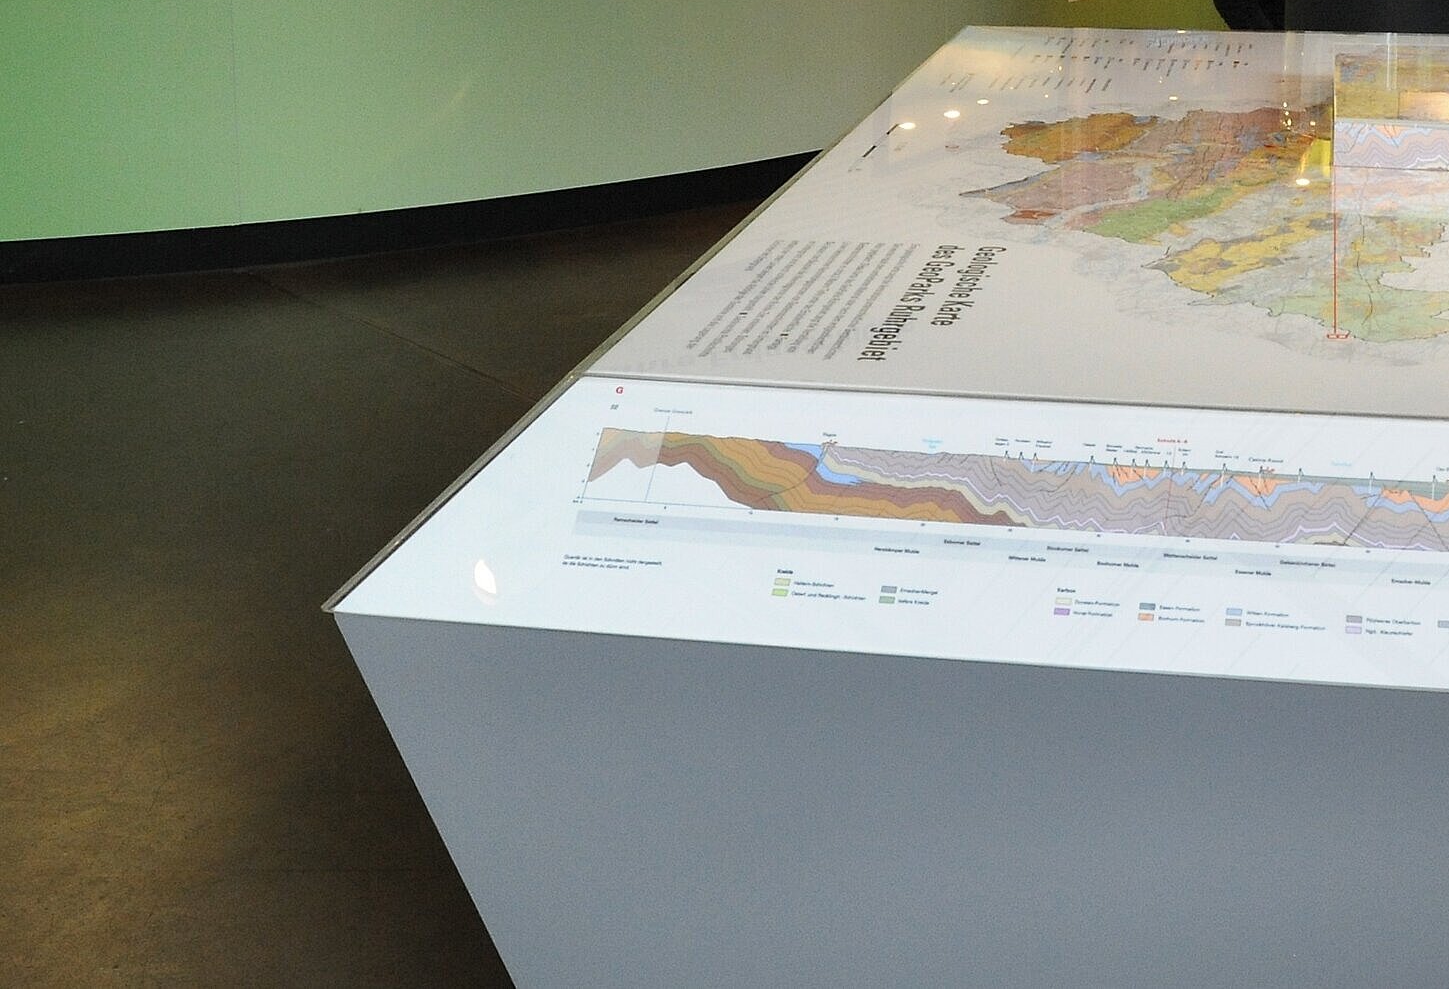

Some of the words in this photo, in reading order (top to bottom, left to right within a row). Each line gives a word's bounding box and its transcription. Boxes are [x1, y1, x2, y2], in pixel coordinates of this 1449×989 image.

[932, 244, 965, 259] des
[900, 260, 955, 303] GeoParks
[948, 246, 1007, 298] Geologische
[931, 300, 975, 326] Karte
[857, 305, 926, 361] Ruhrgebiet
[615, 386, 624, 395] G
